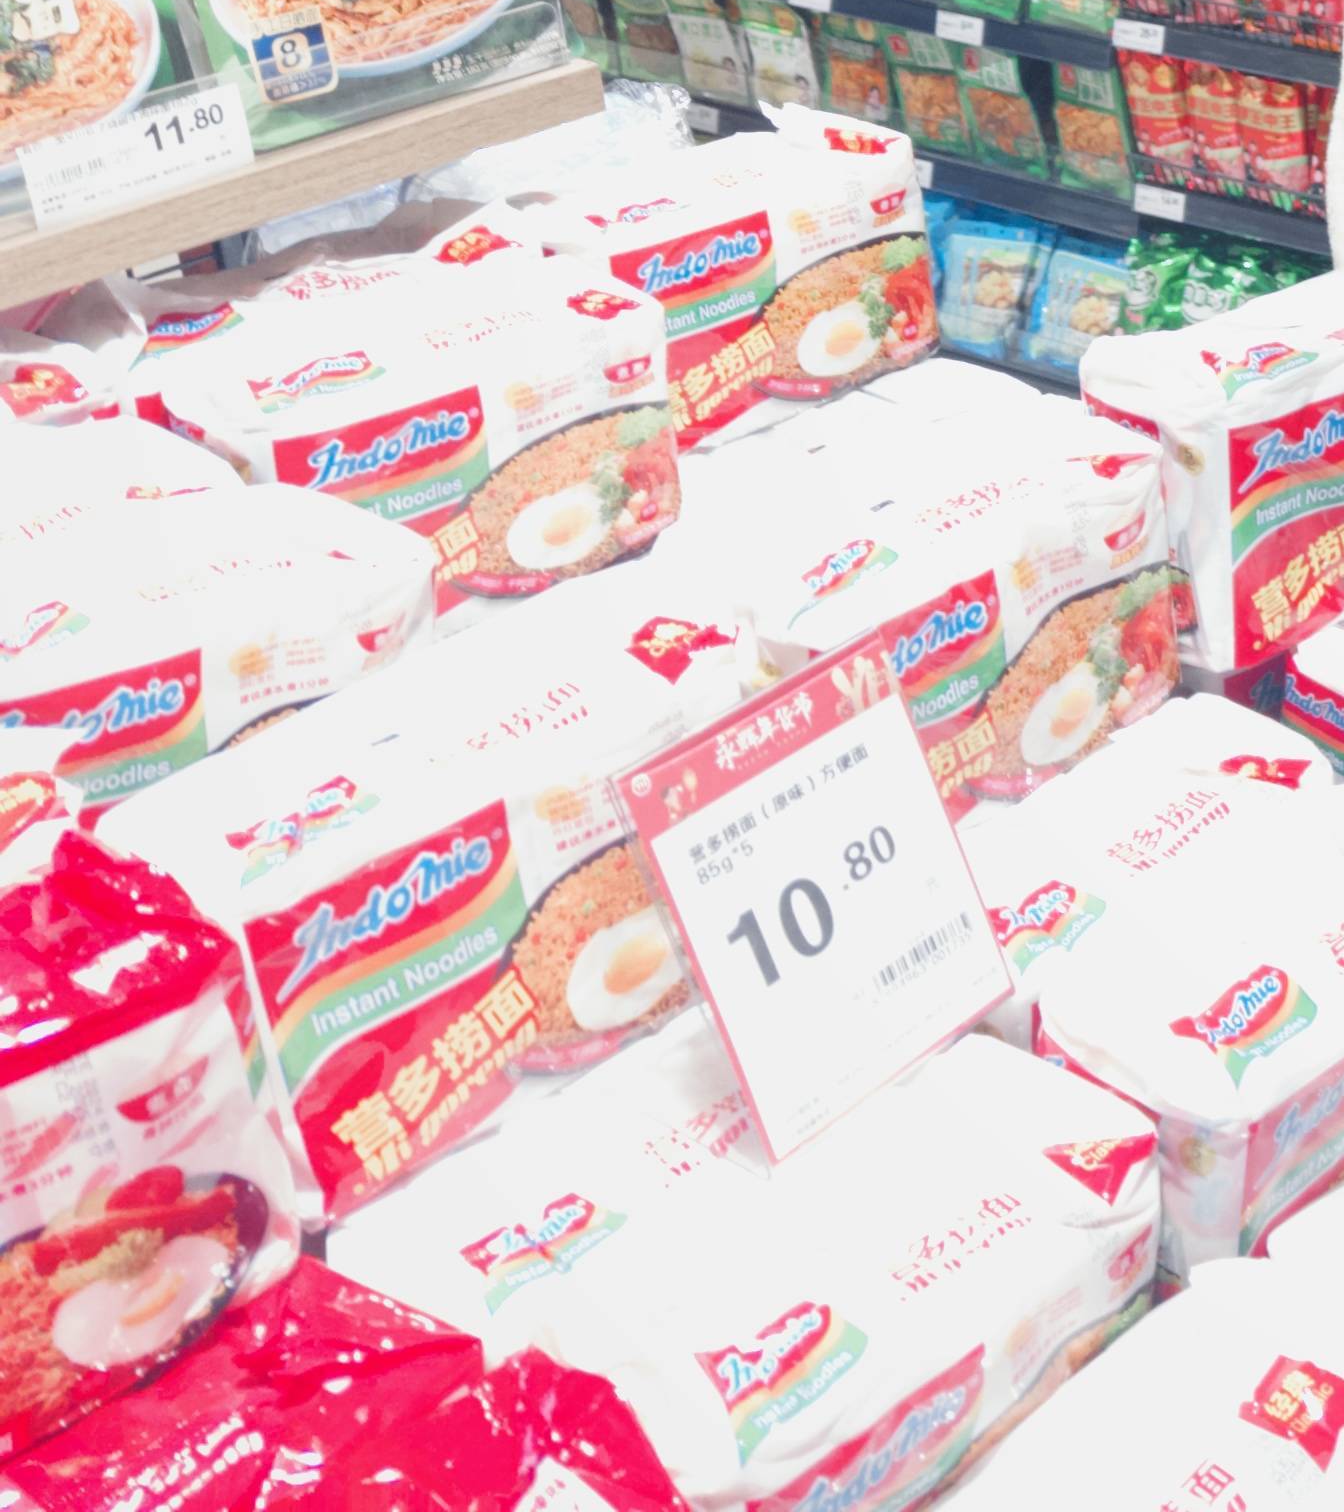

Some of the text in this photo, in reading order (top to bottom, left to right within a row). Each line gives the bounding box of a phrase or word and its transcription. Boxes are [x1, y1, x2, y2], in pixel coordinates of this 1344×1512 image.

[145, 104, 223, 153] 11.80
[700, 290, 757, 321] Noodles
[387, 476, 463, 513] Noodles
[1256, 493, 1301, 526] Instant
[912, 675, 979, 719] Noodles
[726, 824, 896, 987] 10.80
[312, 925, 499, 1037] Instant Noodles
